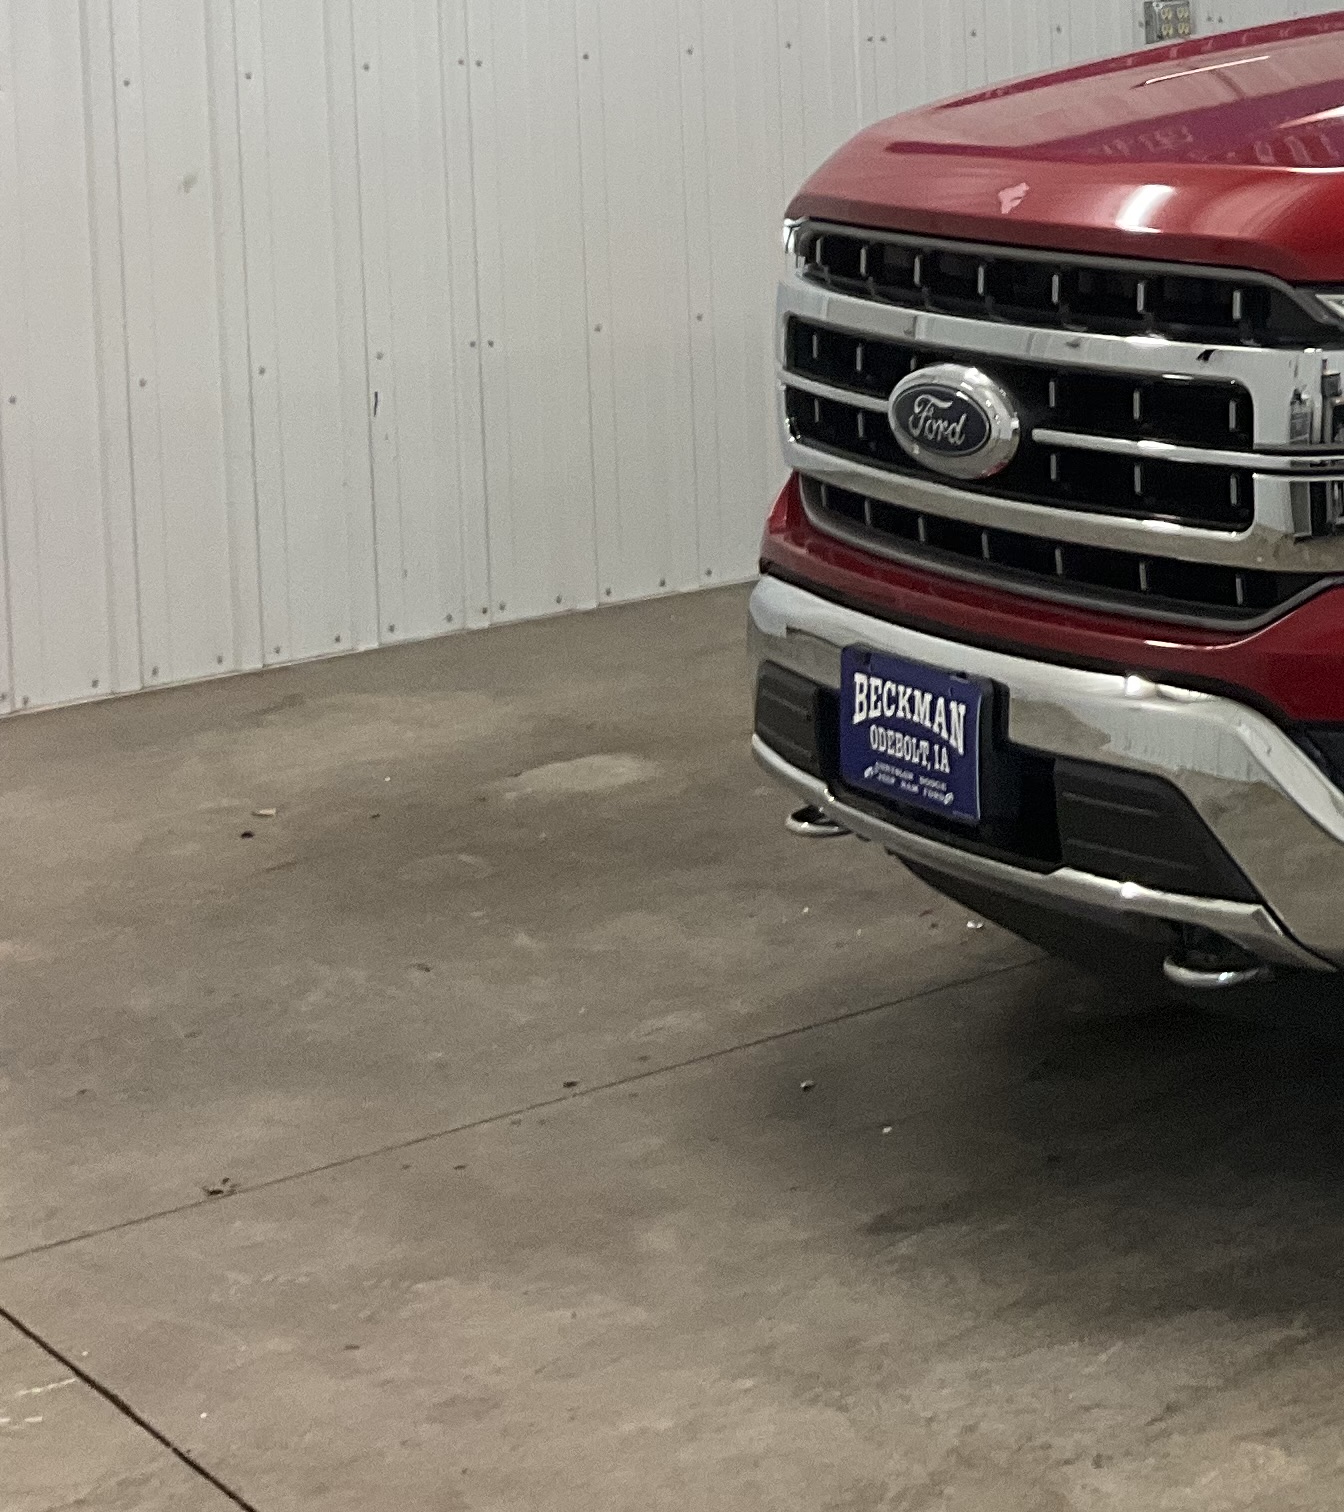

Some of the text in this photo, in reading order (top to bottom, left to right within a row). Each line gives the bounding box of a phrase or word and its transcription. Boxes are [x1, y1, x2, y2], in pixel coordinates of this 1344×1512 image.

[908, 394, 967, 446] Ford
[853, 672, 966, 755] BECKMAN
[869, 724, 950, 774] ODEBOLT, IA
